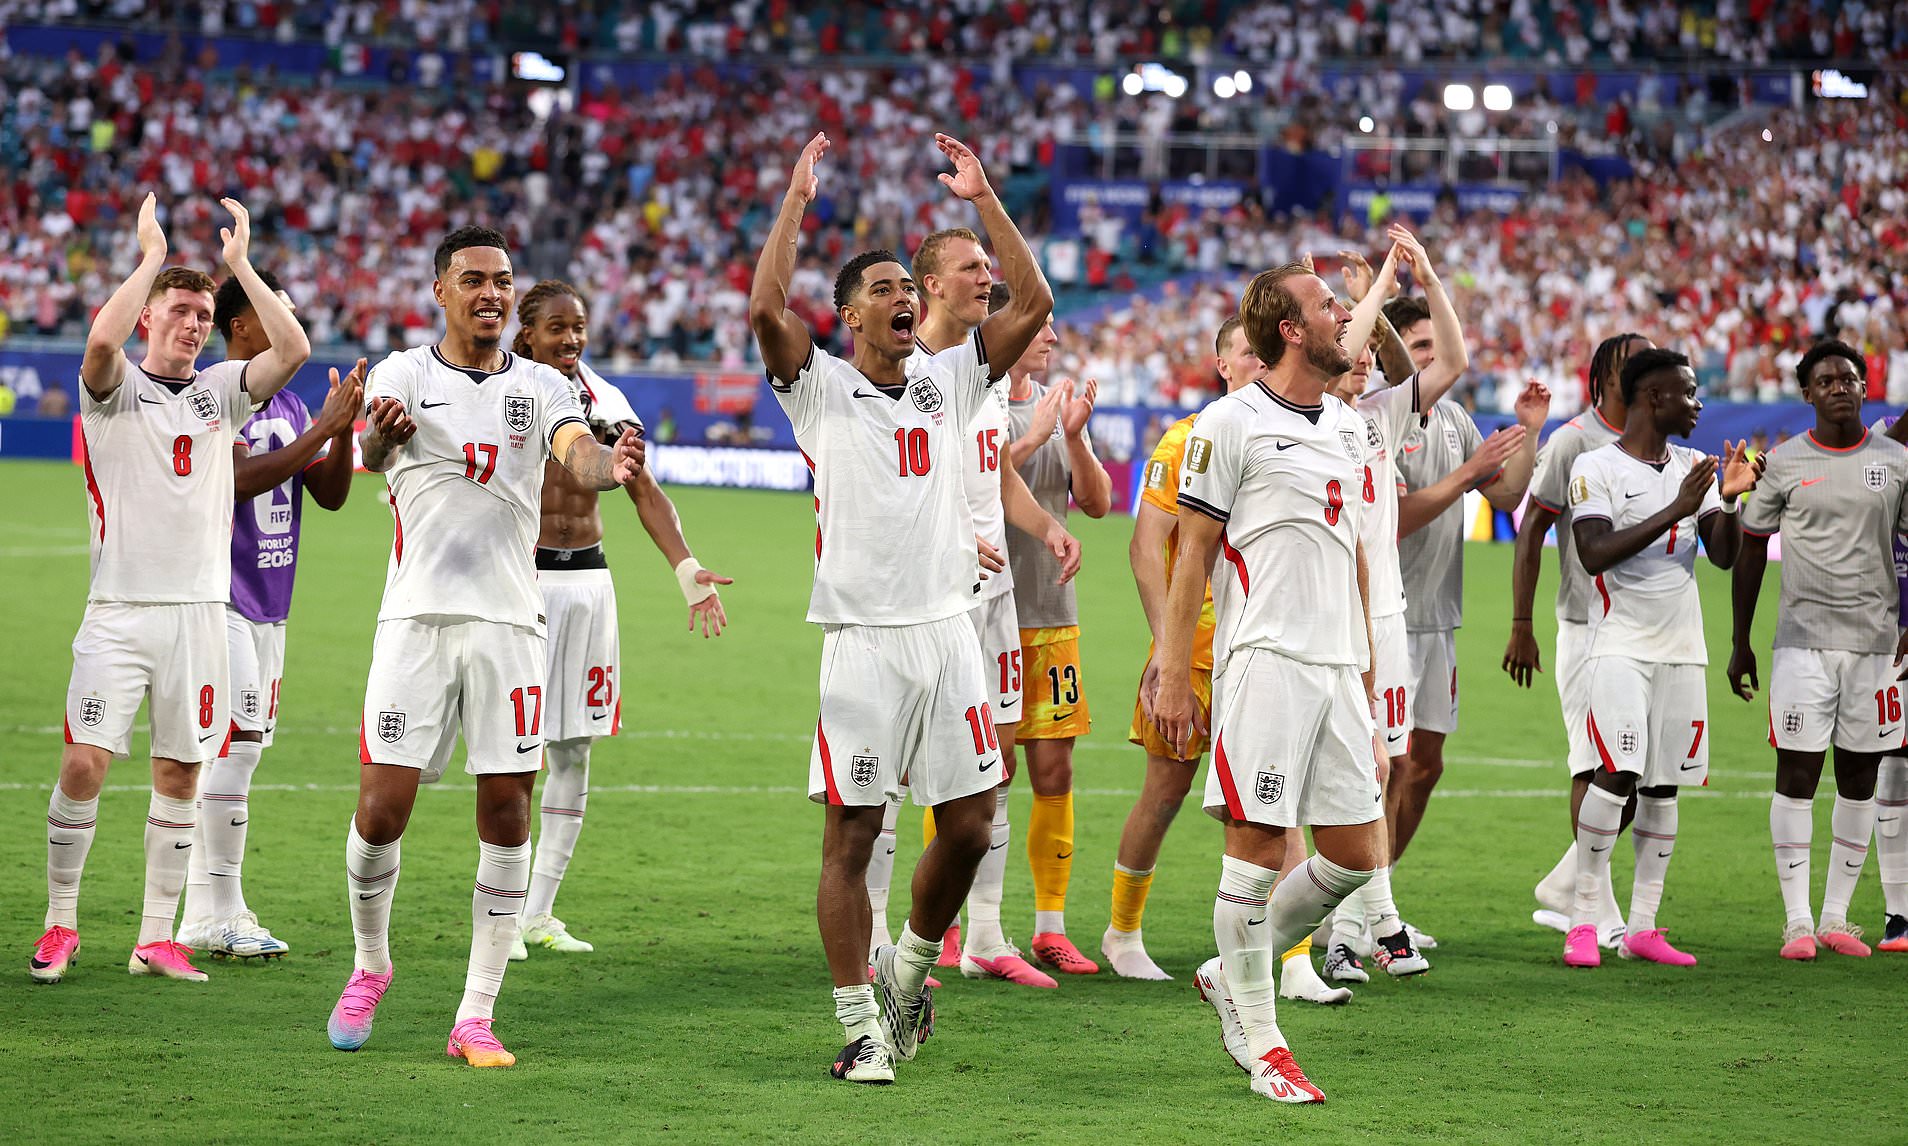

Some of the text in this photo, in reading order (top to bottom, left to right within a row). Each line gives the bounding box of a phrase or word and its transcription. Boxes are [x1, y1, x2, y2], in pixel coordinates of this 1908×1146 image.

[173, 434, 193, 477] 8
[462, 442, 499, 485] 17
[894, 427, 931, 477] 10
[976, 428, 999, 473] 15
[1325, 479, 1344, 527] 9
[587, 665, 613, 707] 25
[997, 648, 1021, 694] 15
[1048, 664, 1079, 706] 13
[199, 684, 214, 729] 8
[510, 685, 542, 737] 17
[1383, 686, 1406, 729] 18
[1874, 685, 1902, 726] 16
[964, 701, 997, 756] 10
[1687, 719, 1705, 759] 7
